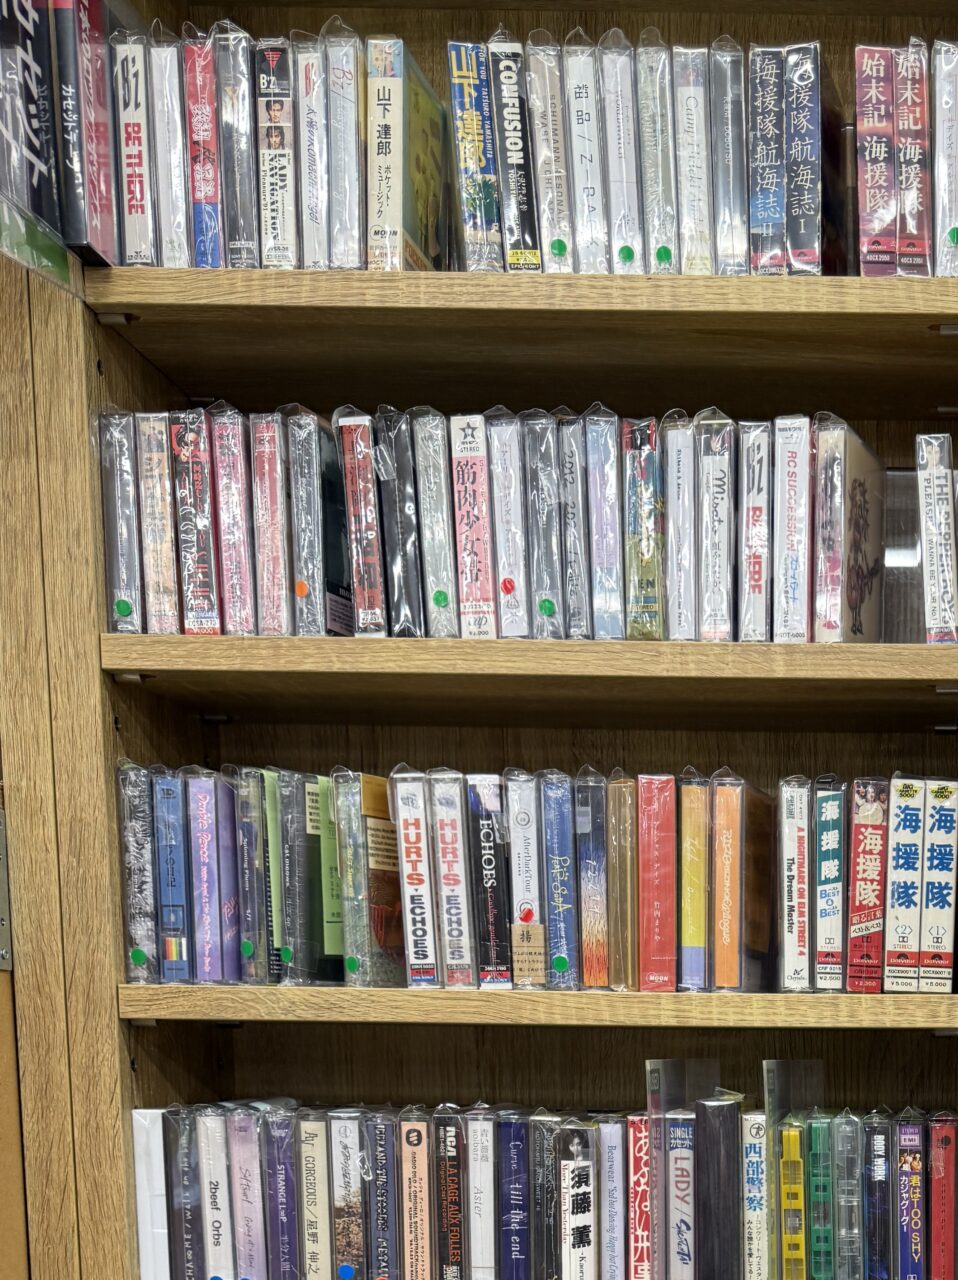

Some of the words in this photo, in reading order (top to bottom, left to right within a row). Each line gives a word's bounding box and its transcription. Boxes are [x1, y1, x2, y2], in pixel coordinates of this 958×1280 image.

[862, 52, 887, 128] 始末記
[897, 52, 922, 131] 始末記
[376, 86, 392, 157] 山下達郎
[500, 60, 523, 164] CONFUSION
[864, 136, 890, 213] 海援隊
[786, 450, 798, 469] RC
[935, 471, 948, 509] THE
[785, 471, 798, 553] SUCCESSION
[402, 818, 425, 886] HURTS
[439, 819, 461, 886] HURTS
[480, 819, 497, 888] ECHOES
[821, 802, 840, 881] 海援隊
[891, 805, 921, 910] 海援隊
[925, 806, 956, 910] 海援隊
[856, 827, 883, 907] 海援隊
[787, 875, 795, 902] Dream
[409, 895, 429, 960] ECHOES
[445, 895, 465, 960] ECHOES
[670, 1127, 693, 1138] SINGLE
[670, 1139, 693, 1148] カセット
[874, 1135, 885, 1155] BODY
[447, 1161, 458, 1174] LA
[607, 1145, 617, 1182] Bearwear
[674, 1156, 690, 1205] LADY
[874, 1158, 885, 1181] WORK
[209, 1180, 220, 1211] 2beef
[277, 1165, 285, 1202] STRANGE
[447, 1177, 459, 1202] CAGE
[473, 1186, 484, 1218] Aster
[510, 1183, 522, 1204] till
[909, 1175, 922, 1229] 君はTOO
[448, 1205, 459, 1224] AUX
[510, 1209, 523, 1229] the
[900, 1175, 908, 1233] カジャグーグー
[211, 1220, 222, 1247] Orbs
[449, 1227, 461, 1262] FOLLES
[510, 1236, 524, 1259] end
[910, 1232, 922, 1263] SHY
